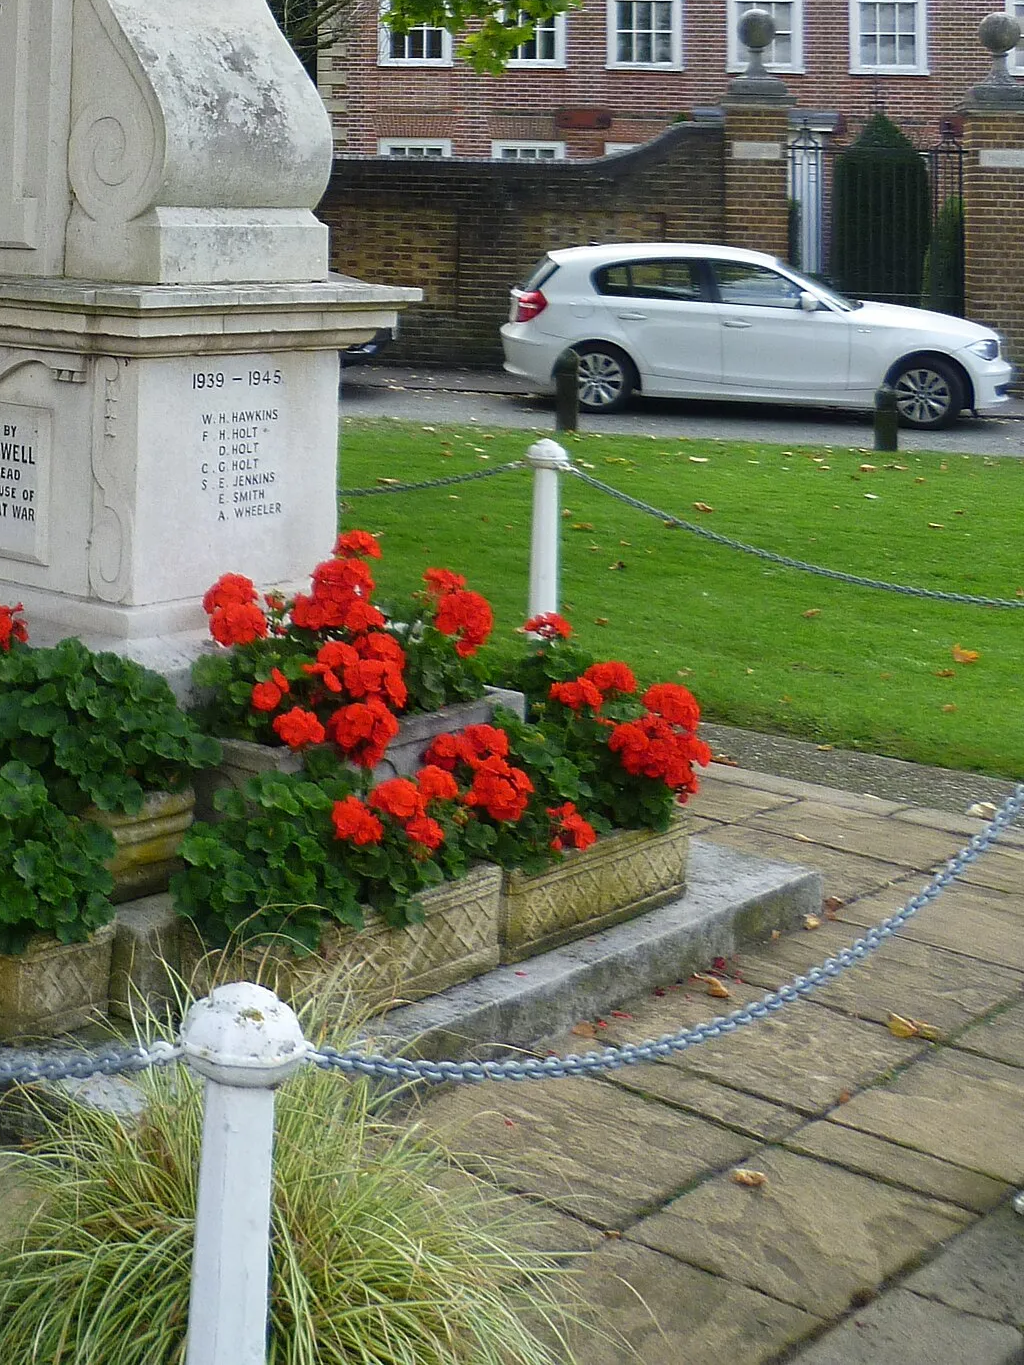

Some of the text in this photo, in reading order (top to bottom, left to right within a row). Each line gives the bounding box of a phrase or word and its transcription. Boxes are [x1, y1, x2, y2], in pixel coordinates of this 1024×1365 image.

[193, 372, 224, 389] 1939
[232, 409, 278, 422] HAWKINS
[3, 424, 17, 437] BY
[232, 427, 258, 439] HOLT
[232, 442, 259, 454] HOLT
[232, 458, 259, 471] HOLT
[233, 472, 275, 486] JENKINS
[22, 489, 34, 502] OF
[233, 489, 264, 503] SMITH
[12, 504, 35, 522] WAR
[234, 502, 282, 518] WHEELER
